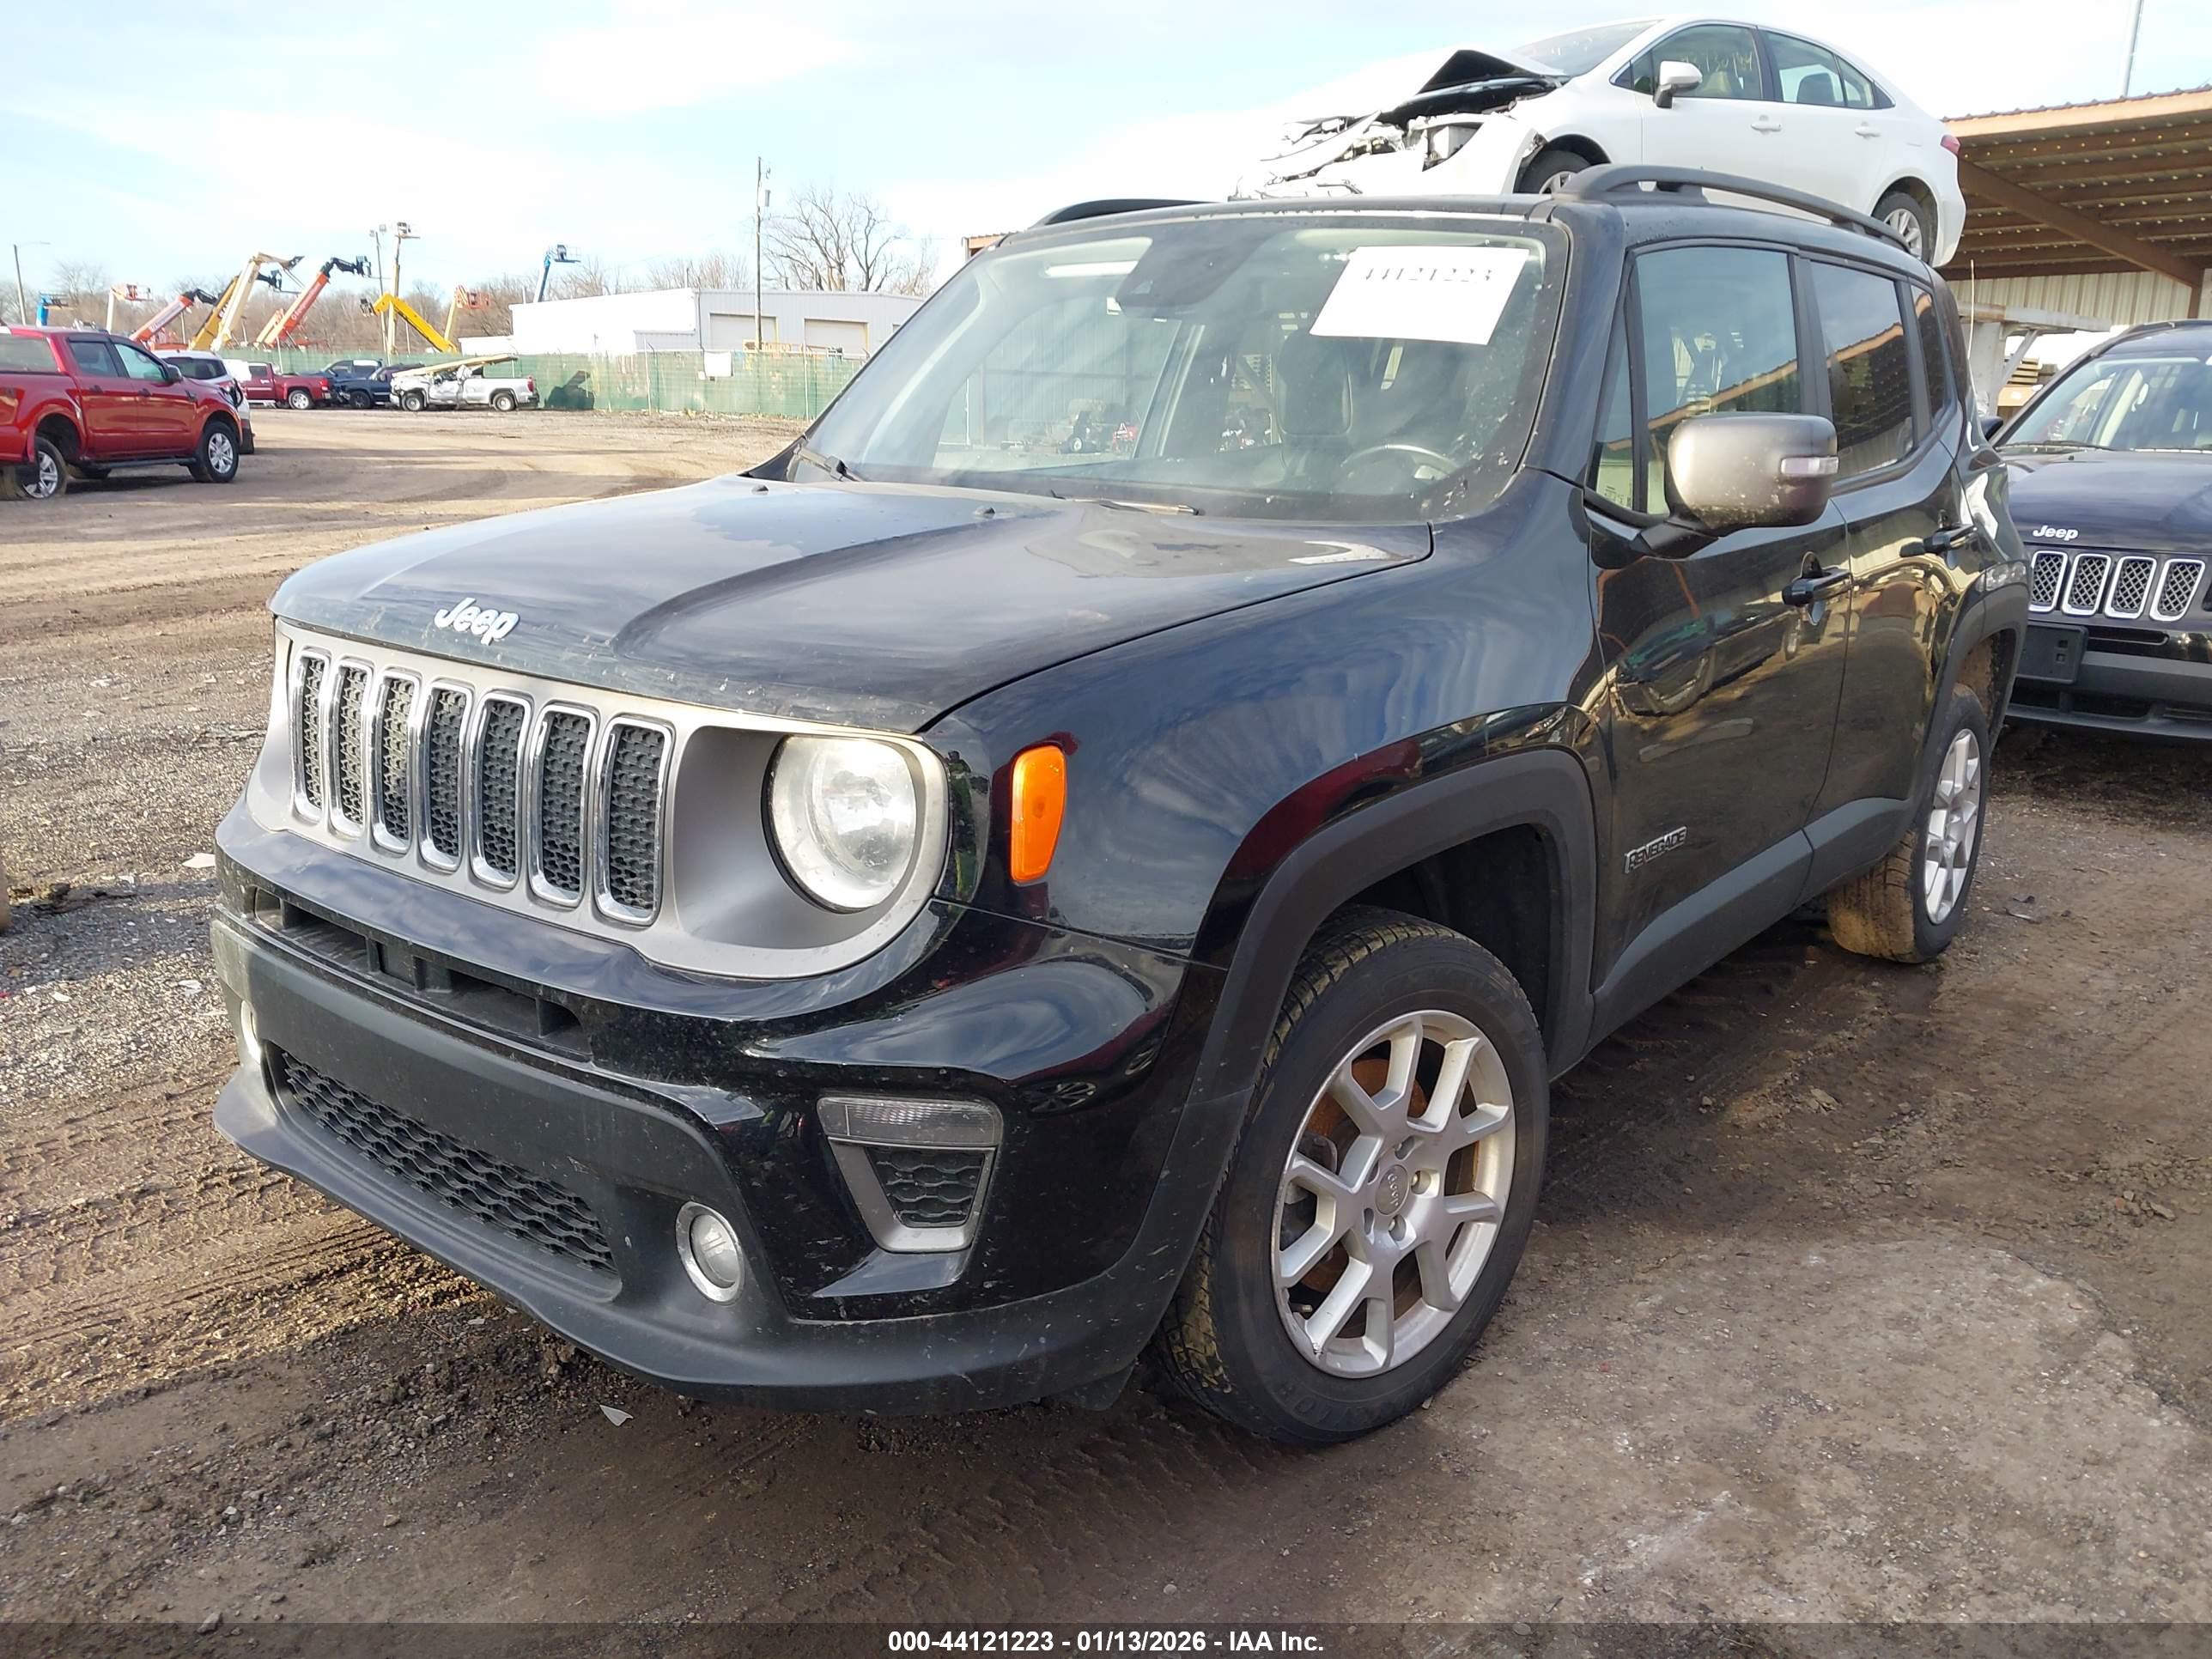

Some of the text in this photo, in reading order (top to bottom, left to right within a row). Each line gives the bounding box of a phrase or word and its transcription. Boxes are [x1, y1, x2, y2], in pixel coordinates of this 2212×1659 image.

[2033, 525, 2078, 541] Jeep
[434, 597, 520, 646] Jeep
[1624, 825, 1687, 873] RENEGADE
[1388, 1173, 1399, 1206] Jeep
